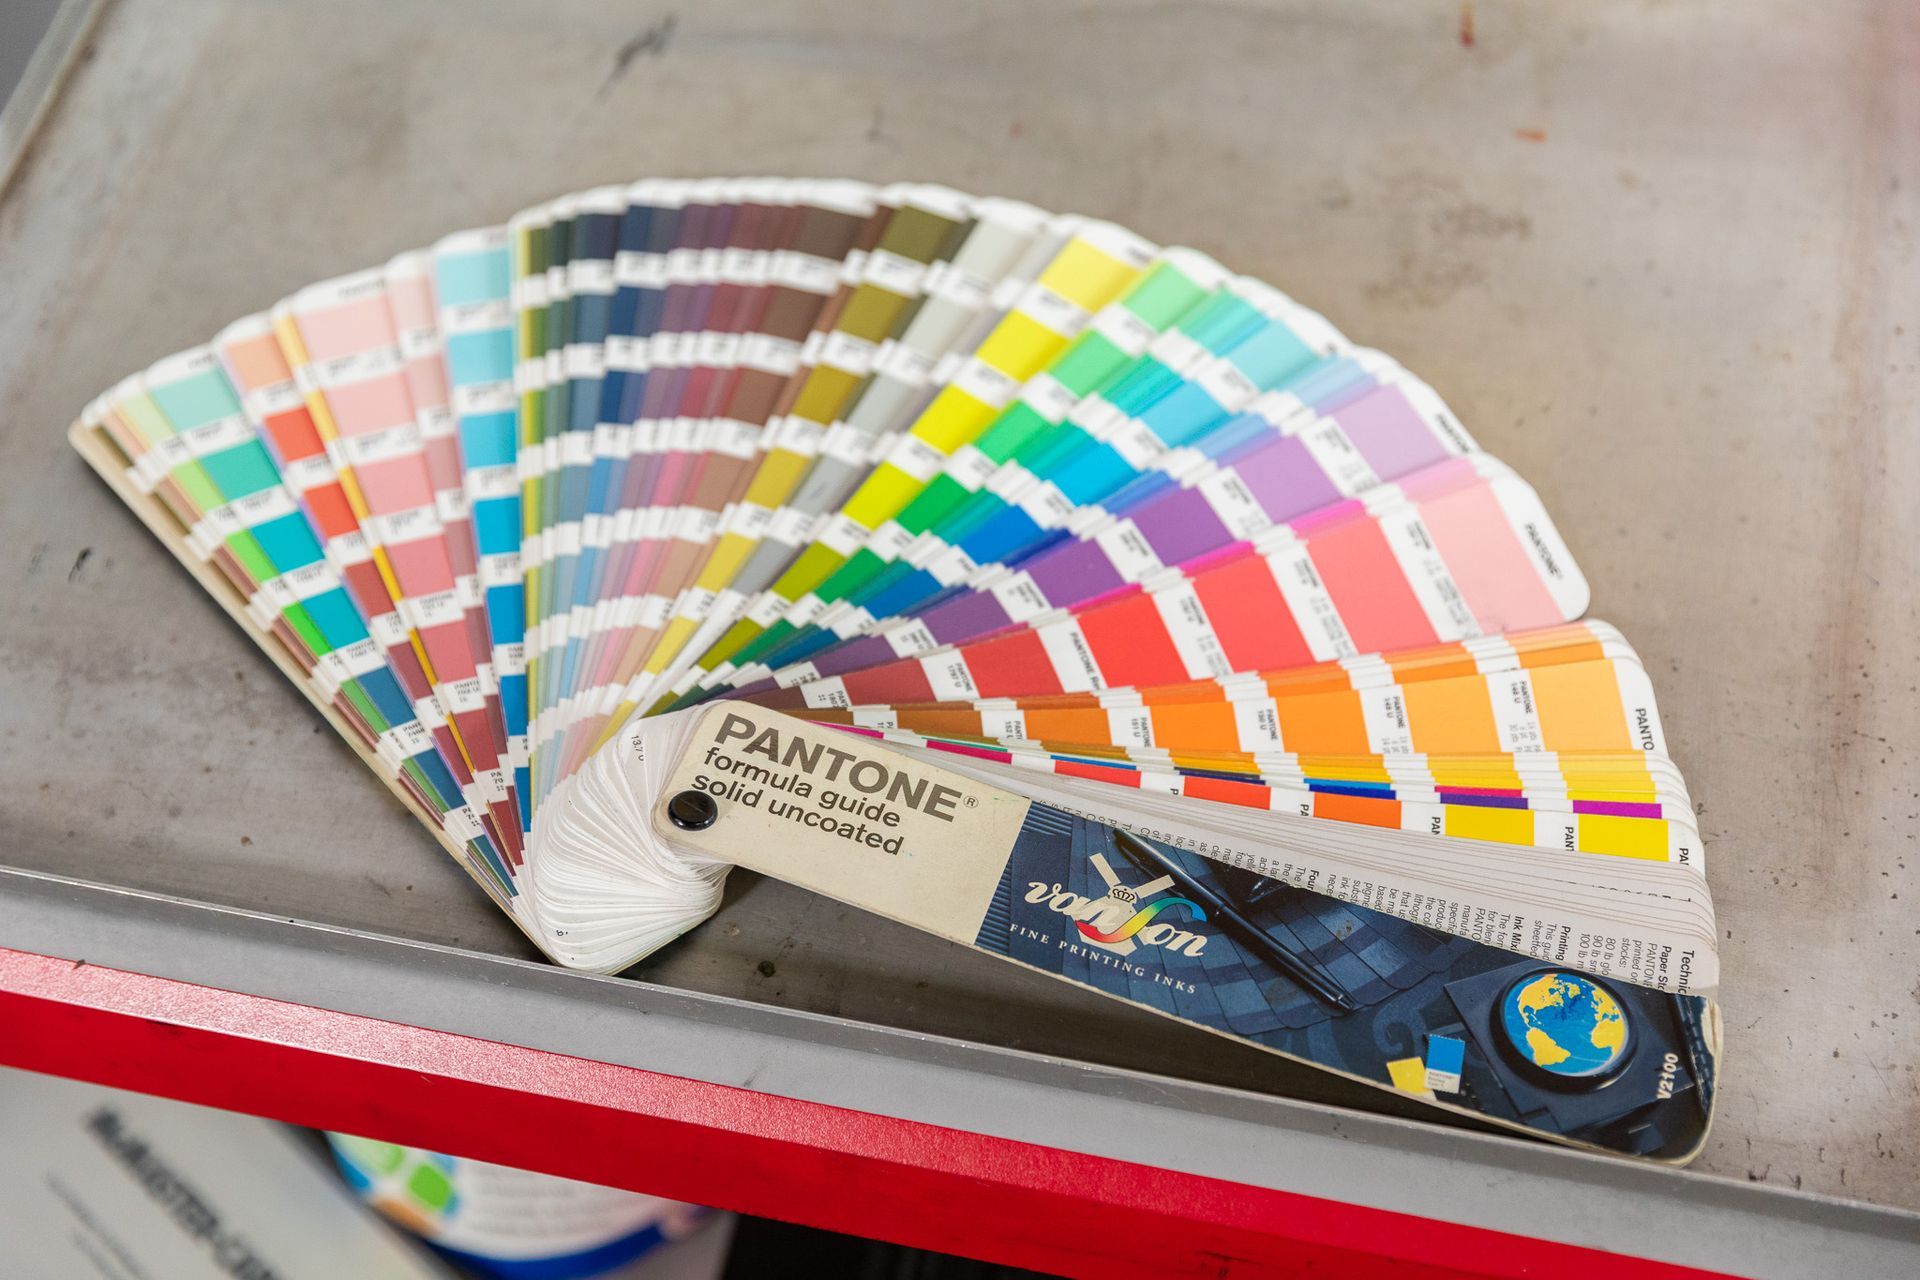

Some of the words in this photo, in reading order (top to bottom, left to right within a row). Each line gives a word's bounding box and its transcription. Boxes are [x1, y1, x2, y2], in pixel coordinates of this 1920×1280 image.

[1070, 631, 1095, 675] PANTONE
[955, 662, 973, 692] PANTONE
[1393, 696, 1405, 728] PANTONE
[1520, 680, 1533, 714] PANTONE
[1140, 717, 1151, 748] PANTONE
[1266, 708, 1278, 741] PANTONE
[1635, 708, 1655, 751] PANTO
[703, 747, 814, 799] formula
[818, 790, 901, 828] guide
[691, 775, 763, 811] solid
[767, 799, 905, 857] uncoated
[1300, 803, 1310, 817] PA
[1199, 842, 1208, 853] as
[1281, 862, 1294, 877] the
[1294, 866, 1306, 883] The
[1307, 869, 1320, 891] Four
[1339, 876, 1351, 890] ink
[1374, 885, 1387, 911] based
[1388, 888, 1399, 899] be
[1400, 891, 1412, 909] that
[1424, 896, 1437, 911] the
[1459, 904, 1471, 936] manufa
[1471, 906, 1486, 941] PANTO
[1487, 910, 1499, 924] for
[1499, 913, 1511, 930] The
[1513, 915, 1525, 930] Ink
[1545, 923, 1557, 941] This
[1529, 919, 1542, 959] sheetfed
[1555, 924, 1571, 961] Printing
[1579, 933, 1591, 949] 100
[1592, 935, 1604, 949] 90
[1605, 937, 1617, 954] 80
[1618, 937, 1630, 968] stocks:
[1010, 923, 1050, 944] FINE
[1058, 939, 1145, 977] PRINTING
[1154, 972, 1197, 994] INKS
[1630, 939, 1643, 974] printed
[1659, 945, 1672, 979] Paper
[1677, 949, 1695, 995] Technic
[1656, 1052, 1679, 1100] V2100
